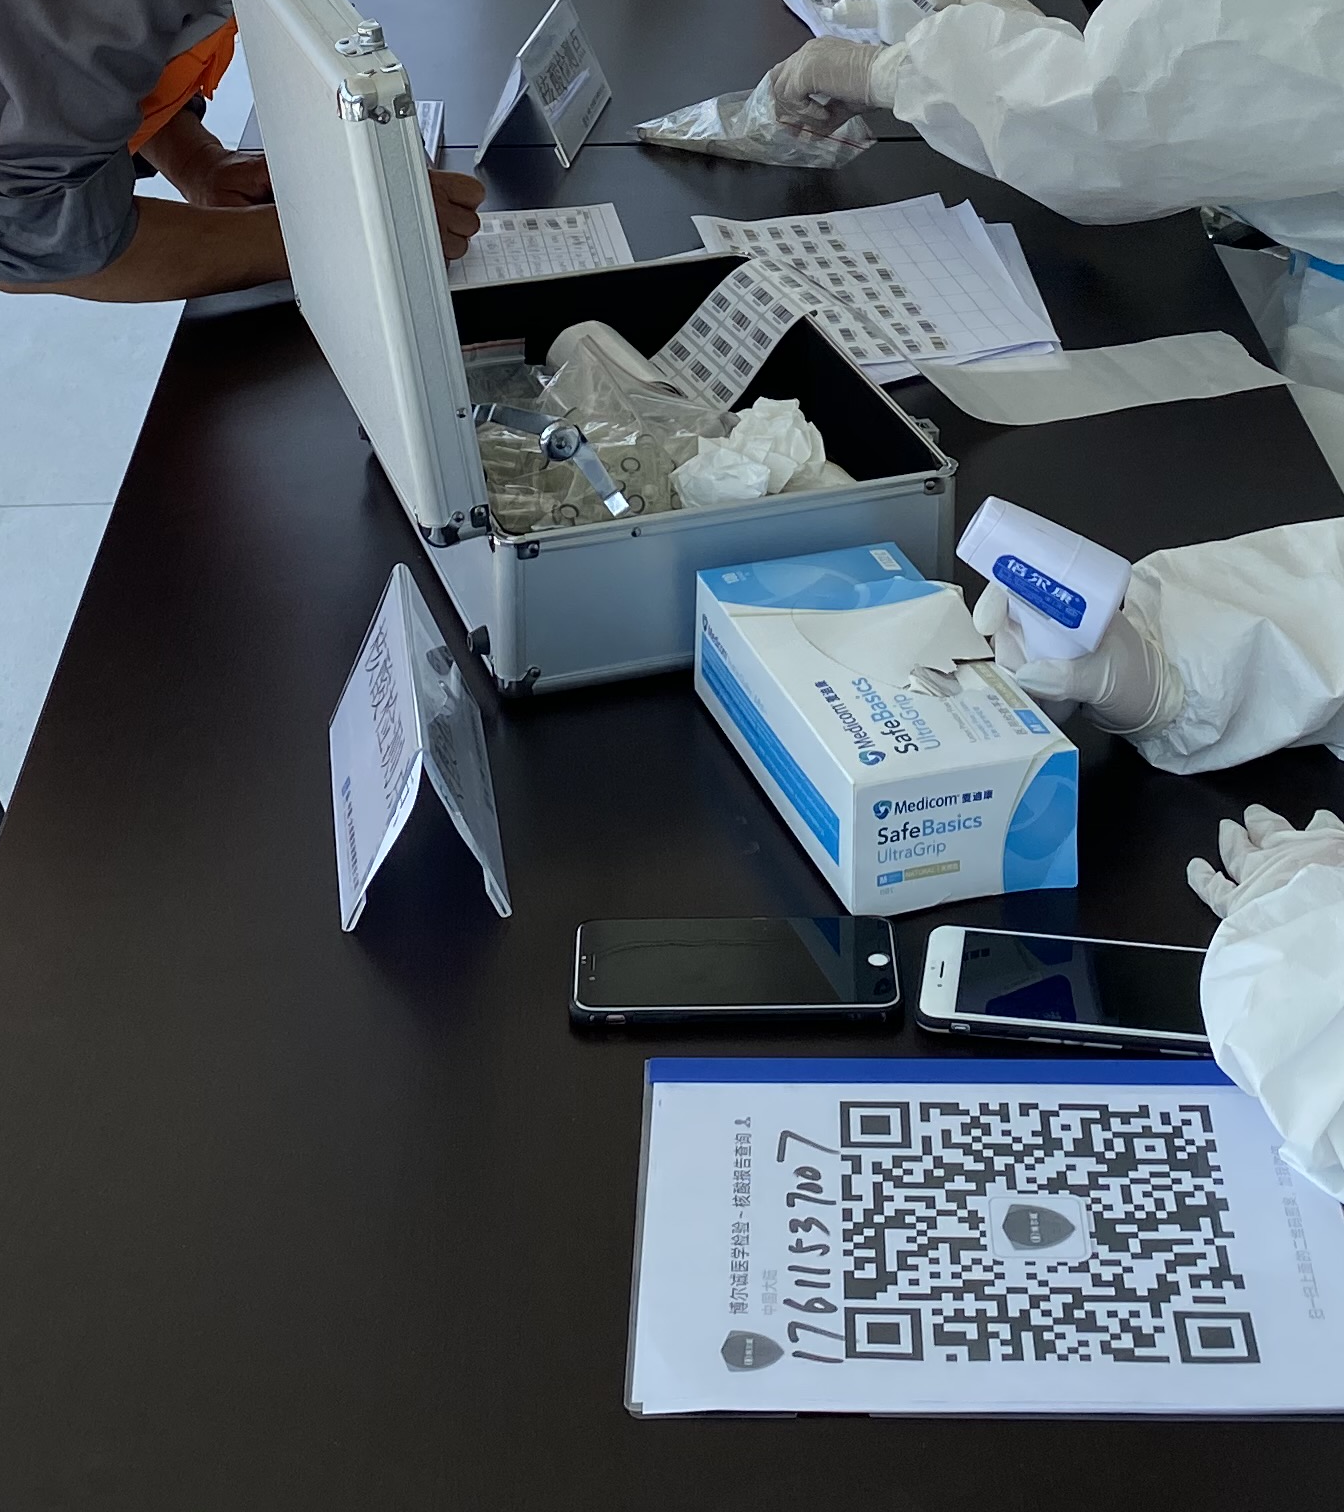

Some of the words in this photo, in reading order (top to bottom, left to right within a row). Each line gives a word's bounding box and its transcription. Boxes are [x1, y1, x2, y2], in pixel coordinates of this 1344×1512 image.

[831, 702, 876, 750] Medicom
[852, 677, 919, 754] SafeBasics
[893, 694, 941, 750] UltraGrip
[894, 794, 958, 815] Medicom
[877, 813, 982, 845] SafeBasics
[877, 840, 947, 864] UltraGrip
